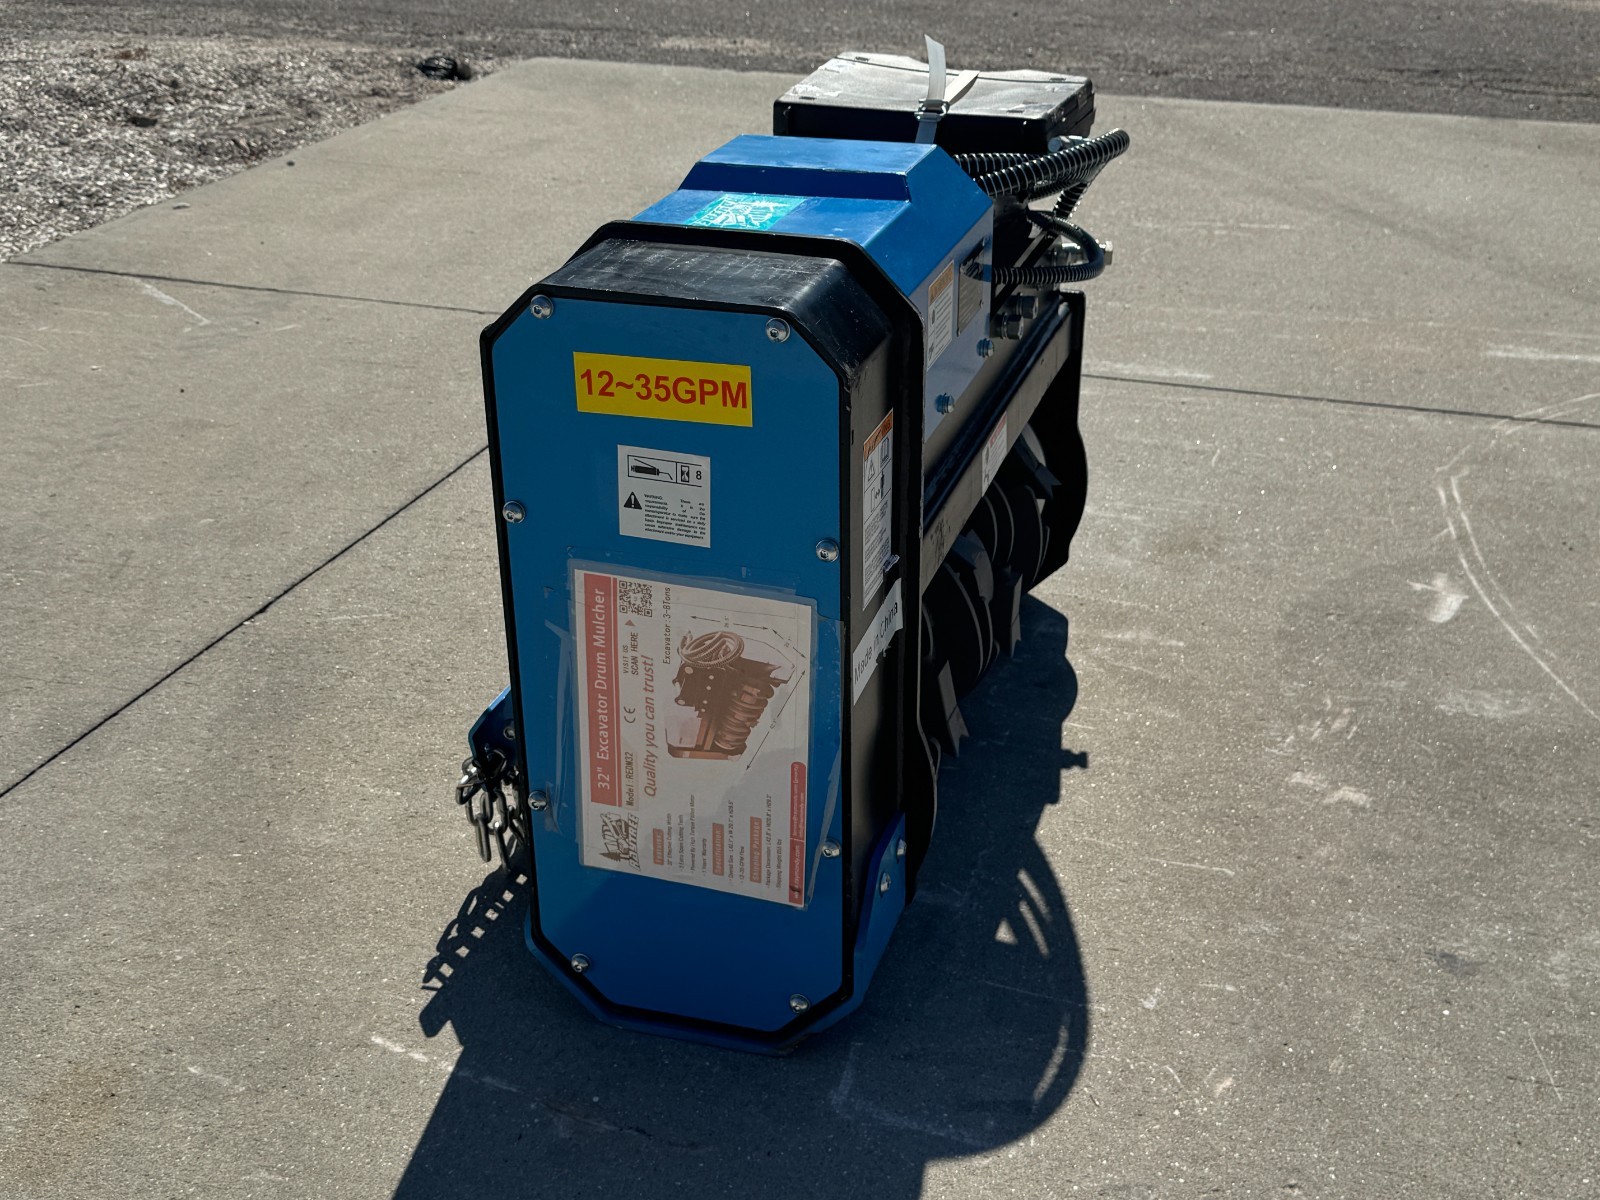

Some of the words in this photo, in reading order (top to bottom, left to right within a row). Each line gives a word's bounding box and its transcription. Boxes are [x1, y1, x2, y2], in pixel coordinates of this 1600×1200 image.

[580, 368, 748, 409] 12~35GPM
[695, 469, 703, 481] 8
[591, 587, 605, 647] Mulcher
[622, 644, 628, 652] US
[630, 631, 638, 652] HERE
[854, 646, 873, 684] Made
[879, 602, 898, 638] China
[593, 651, 606, 689] Drum
[641, 654, 654, 693] trust!
[594, 693, 608, 759] Excavator
[644, 696, 654, 720] can
[644, 722, 658, 747] you
[597, 767, 609, 789] 32"
[643, 749, 658, 797] Quality
